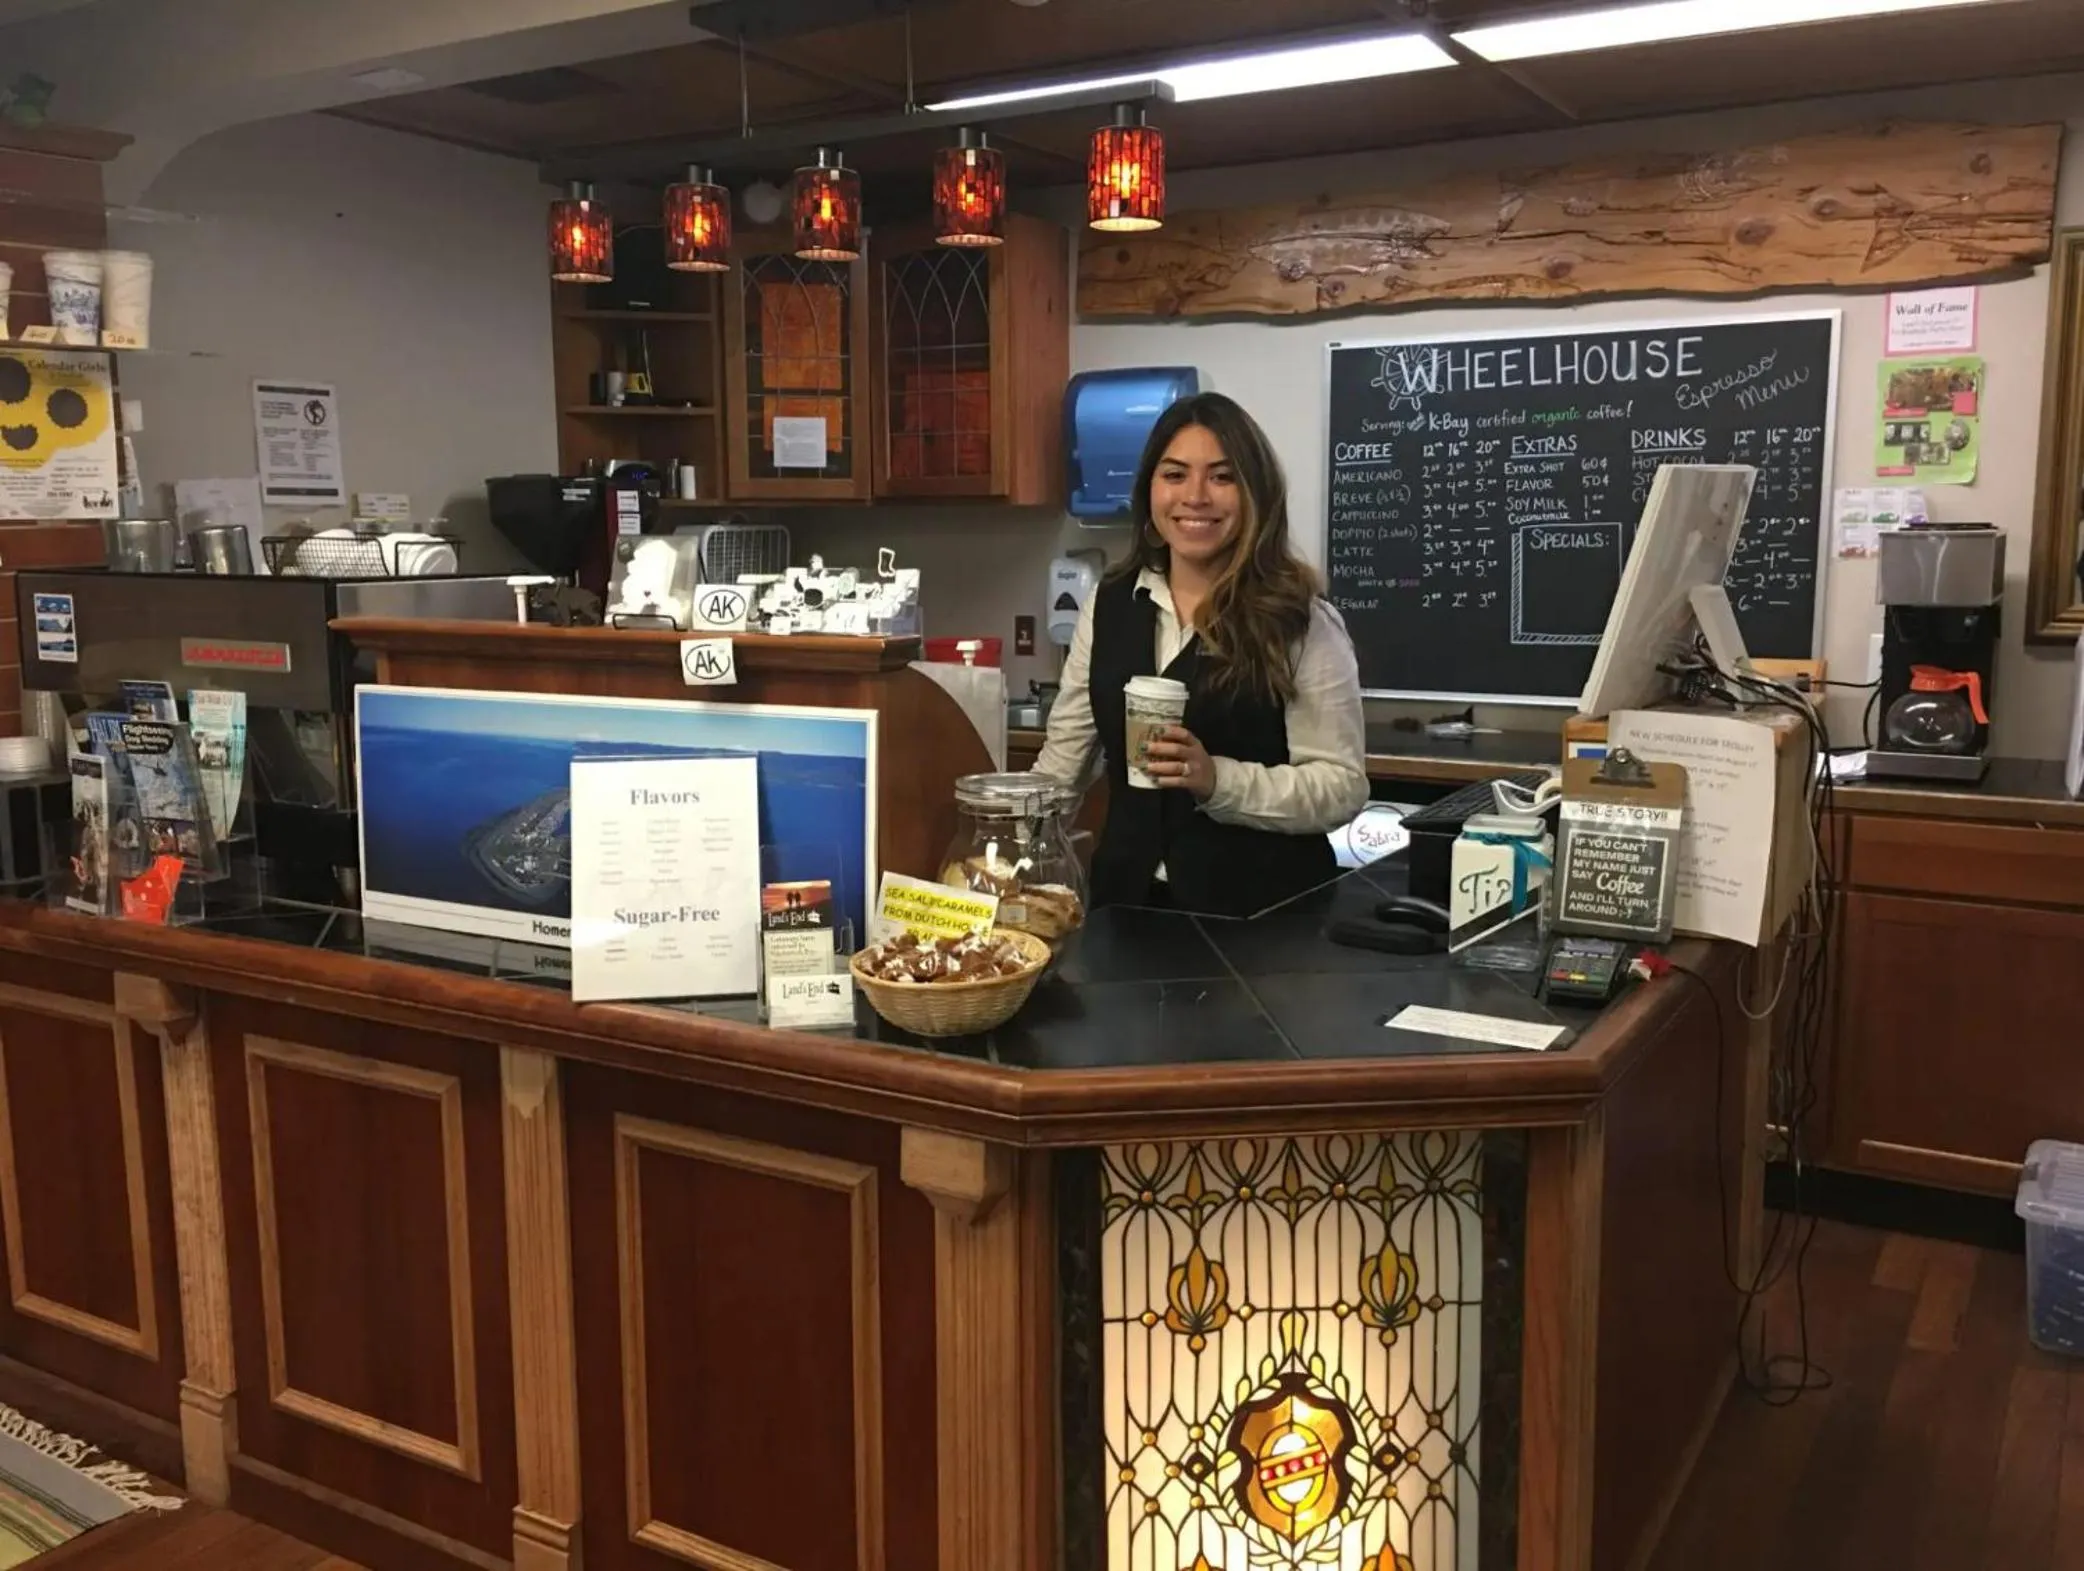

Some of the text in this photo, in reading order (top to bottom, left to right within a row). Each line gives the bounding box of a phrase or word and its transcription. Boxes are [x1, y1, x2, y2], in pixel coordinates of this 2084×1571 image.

[1896, 302, 1968, 315] Wall of Fame
[1399, 336, 1703, 393] WHEELHOUSE
[1675, 349, 1778, 409] Espresso
[1735, 367, 1810, 411] Menu
[1429, 412, 1468, 437] K-Bay
[1476, 408, 1526, 428] certified
[1532, 406, 1580, 428] organic
[1511, 435, 1578, 455] EXTRAS
[1632, 427, 1707, 449] DRINKS
[1335, 442, 1393, 460] COFFEE
[1503, 461, 1537, 475] EXTRA
[1539, 461, 1565, 473] SHOT
[1632, 455, 1660, 469] HOT
[1333, 469, 1403, 484] AMERICANO
[1505, 478, 1554, 492] FLAVOR
[1333, 491, 1373, 506] BREVE
[1505, 496, 1531, 512] SOY
[1533, 497, 1568, 510] MILK
[1332, 526, 1376, 540] DOPPIO
[1530, 528, 1610, 550] SPECIALS:
[1333, 546, 1375, 557] LATTE
[1333, 562, 1376, 577] MOCHA
[708, 595, 738, 619] AK
[630, 788, 701, 806] Flavors
[1575, 837, 1648, 853] IF YOU CAN'T
[1573, 848, 1641, 863] REMEMBER
[1572, 858, 1656, 876] MY NAME JUST
[1571, 869, 1646, 896] SAY Coffee
[885, 887, 906, 899] SEA
[937, 898, 993, 919] CARAMELS
[1568, 901, 1618, 915] AROUND
[1569, 890, 1650, 909] AND I'LL TURN
[613, 905, 721, 927] Sugar-Free
[883, 903, 913, 919] FROM
[914, 911, 952, 928] DUTCH
